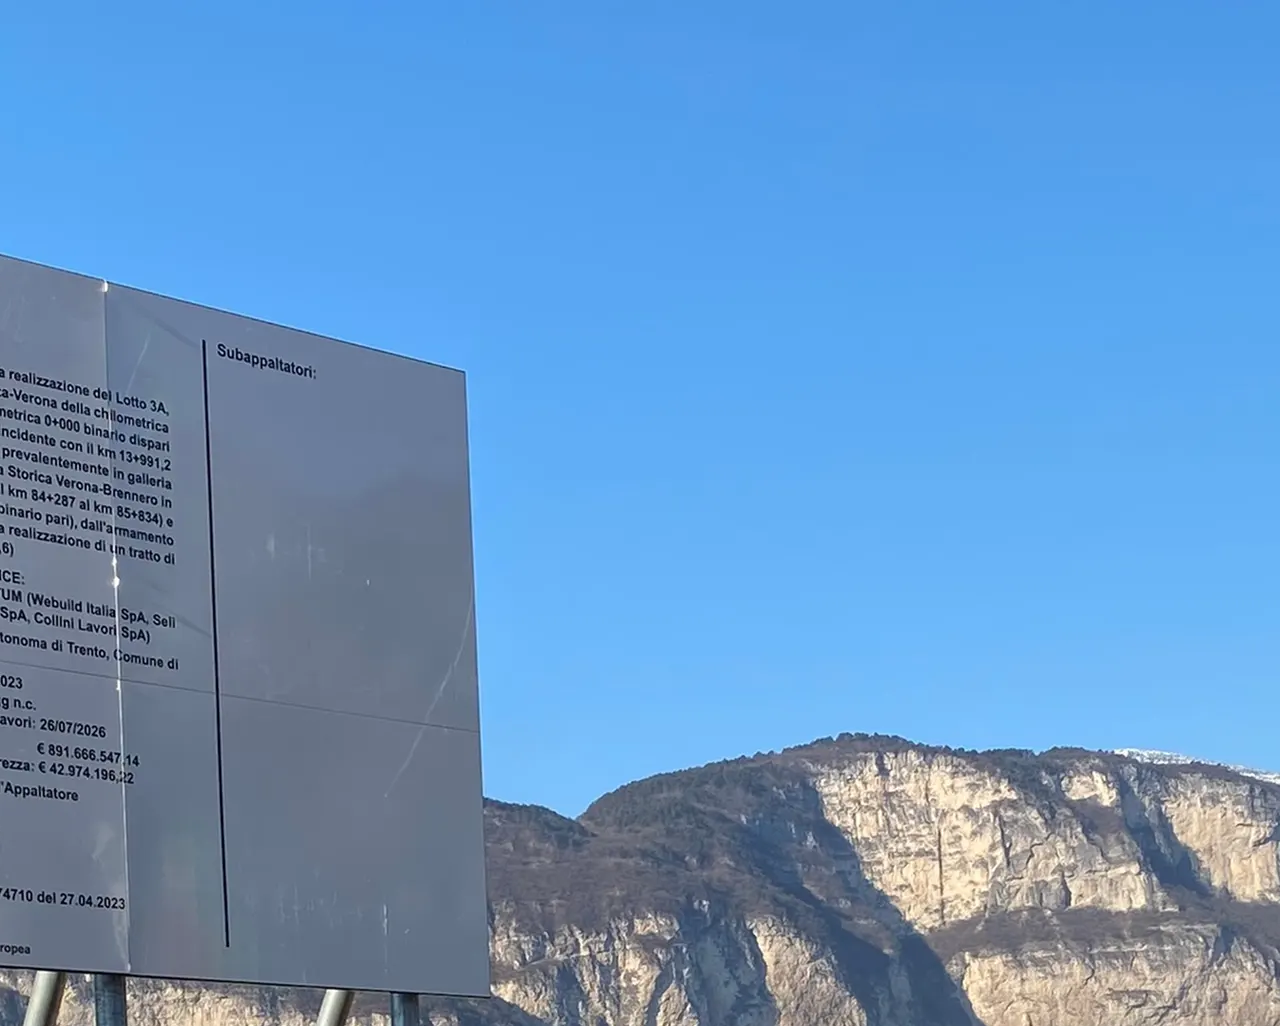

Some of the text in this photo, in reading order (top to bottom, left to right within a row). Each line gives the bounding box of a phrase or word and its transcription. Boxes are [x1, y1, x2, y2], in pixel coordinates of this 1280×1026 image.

[216, 342, 317, 380] Subappaltatori:
[8, 370, 90, 397] realizzazione
[92, 386, 112, 402] del
[115, 391, 148, 410] Lotto
[149, 399, 170, 417] 3A,
[60, 399, 92, 417] della
[93, 406, 170, 434] chilometrica
[26, 591, 83, 613] (Webuild
[86, 601, 116, 619] Italia
[120, 607, 150, 626] SpA,
[152, 613, 176, 629] Seli
[13, 698, 37, 711] n.c.
[39, 717, 107, 739] 26/07/2026
[36, 890, 57, 905] del
[59, 892, 126, 911] 27.04.2023
